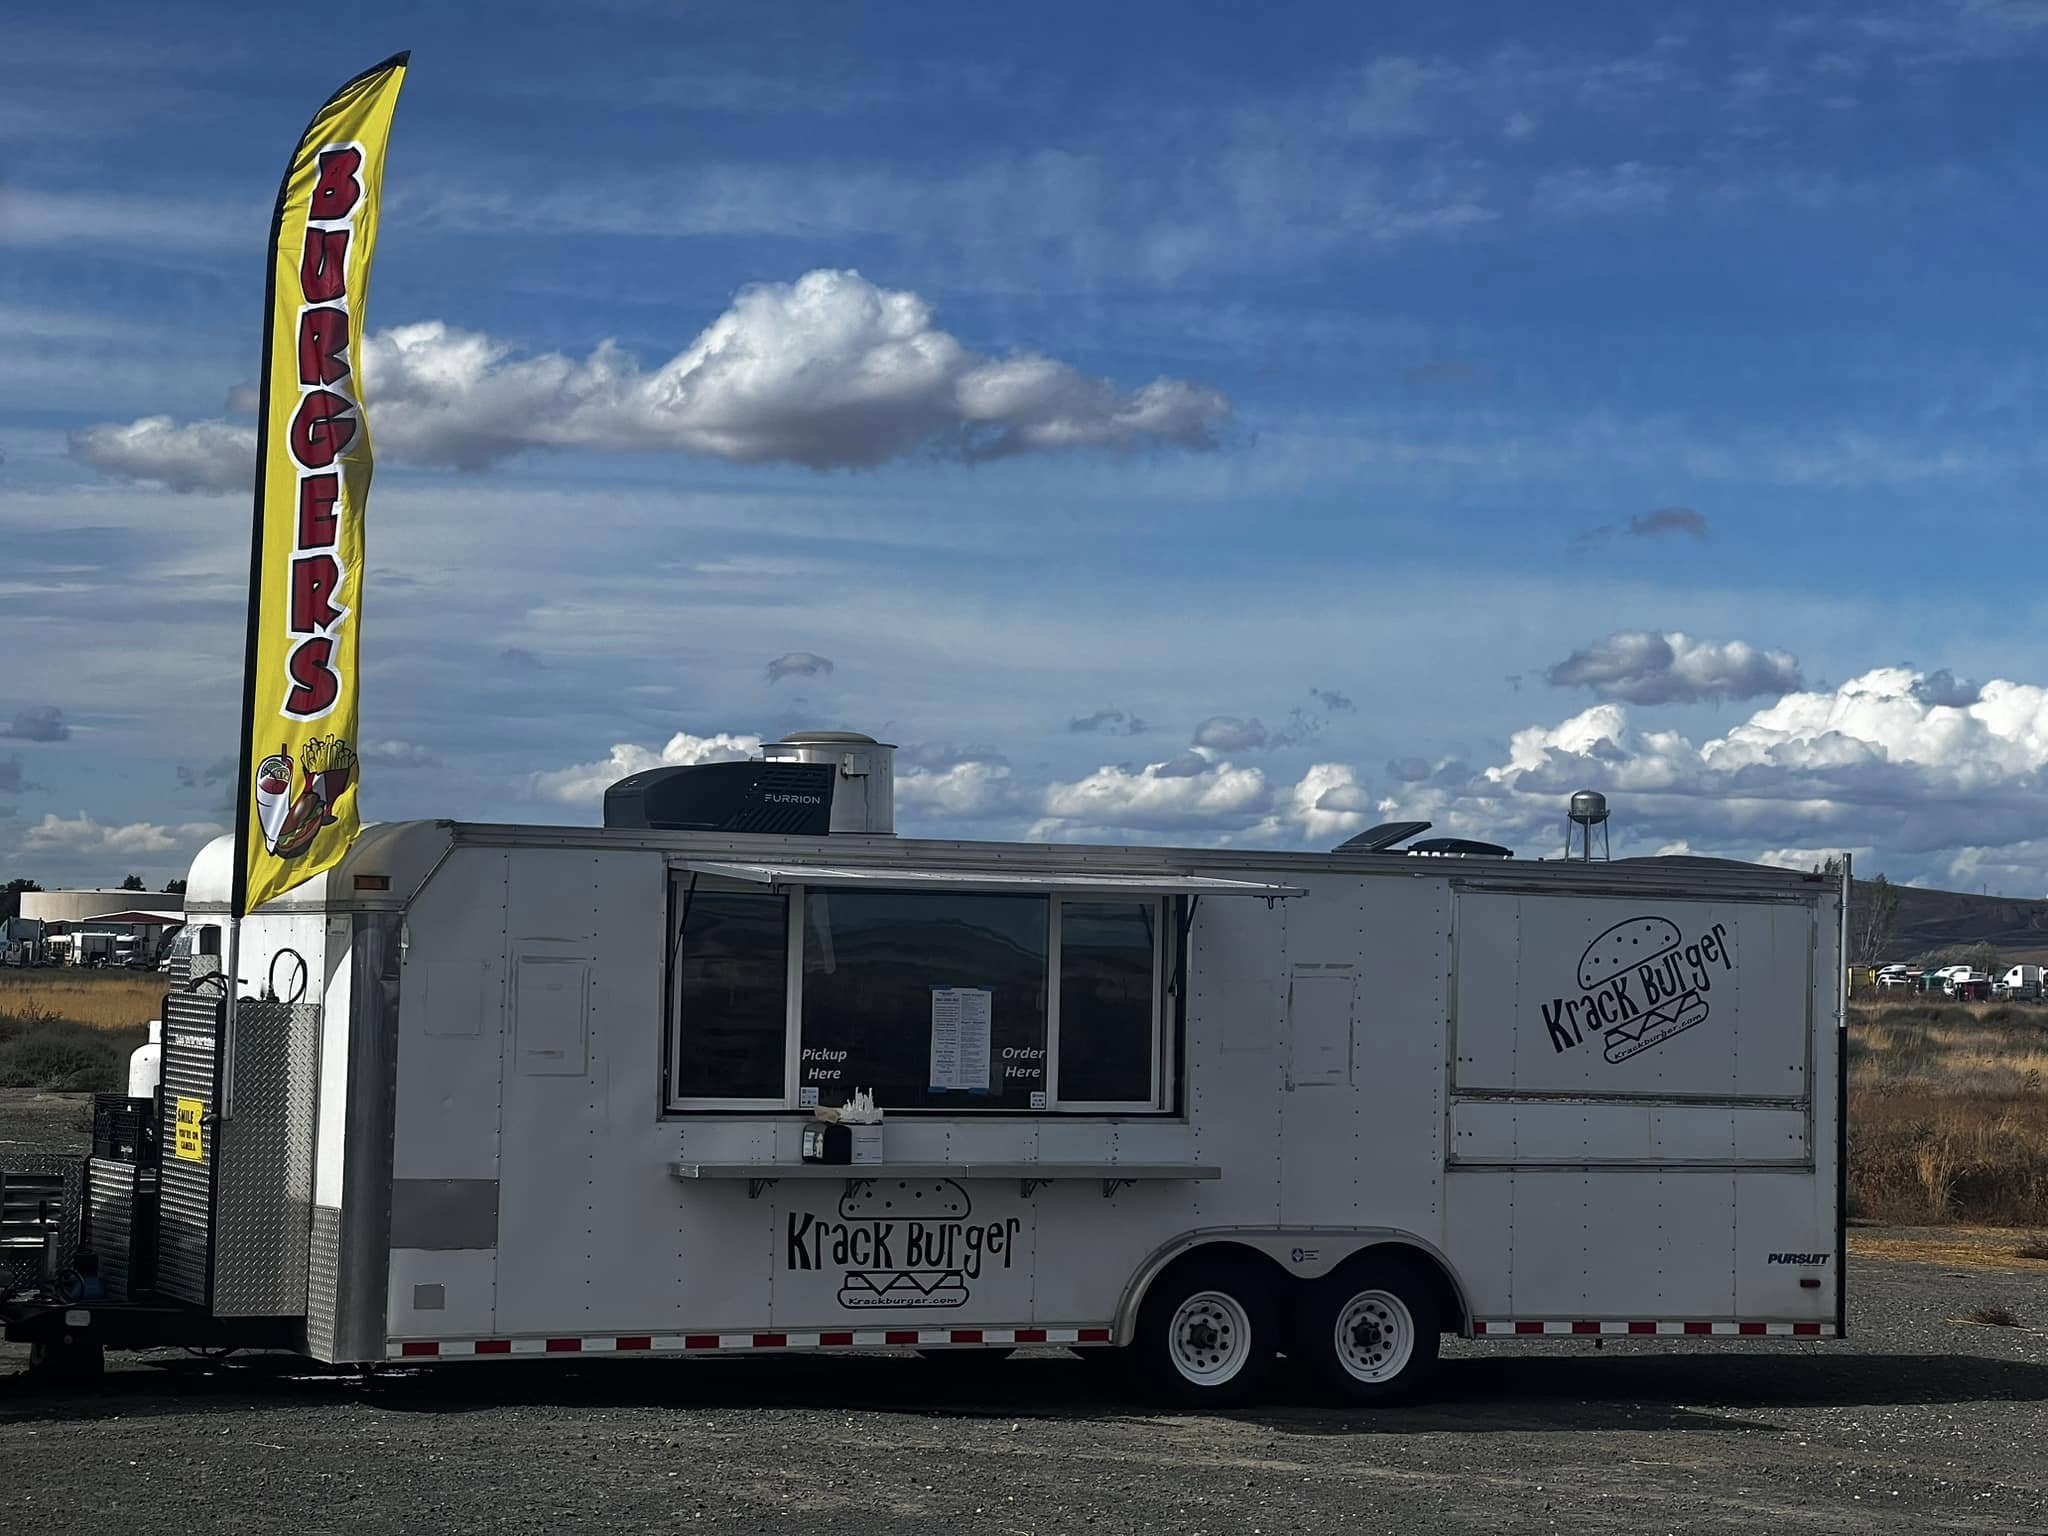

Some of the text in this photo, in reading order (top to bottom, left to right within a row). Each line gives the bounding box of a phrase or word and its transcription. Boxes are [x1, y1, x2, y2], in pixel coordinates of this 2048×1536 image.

[282, 143, 364, 717] BURGERS
[764, 793, 821, 804] FURRION
[1541, 923, 1732, 1054] Krack Burger
[802, 1048, 847, 1062] Pickup
[1002, 1046, 1046, 1059] Order
[808, 1067, 841, 1080] Here
[1005, 1066, 1041, 1078] Here
[178, 1108, 194, 1125] SMILE
[787, 1212, 1020, 1279] Krack Burger
[1767, 1253, 1831, 1264] PURSUIT
